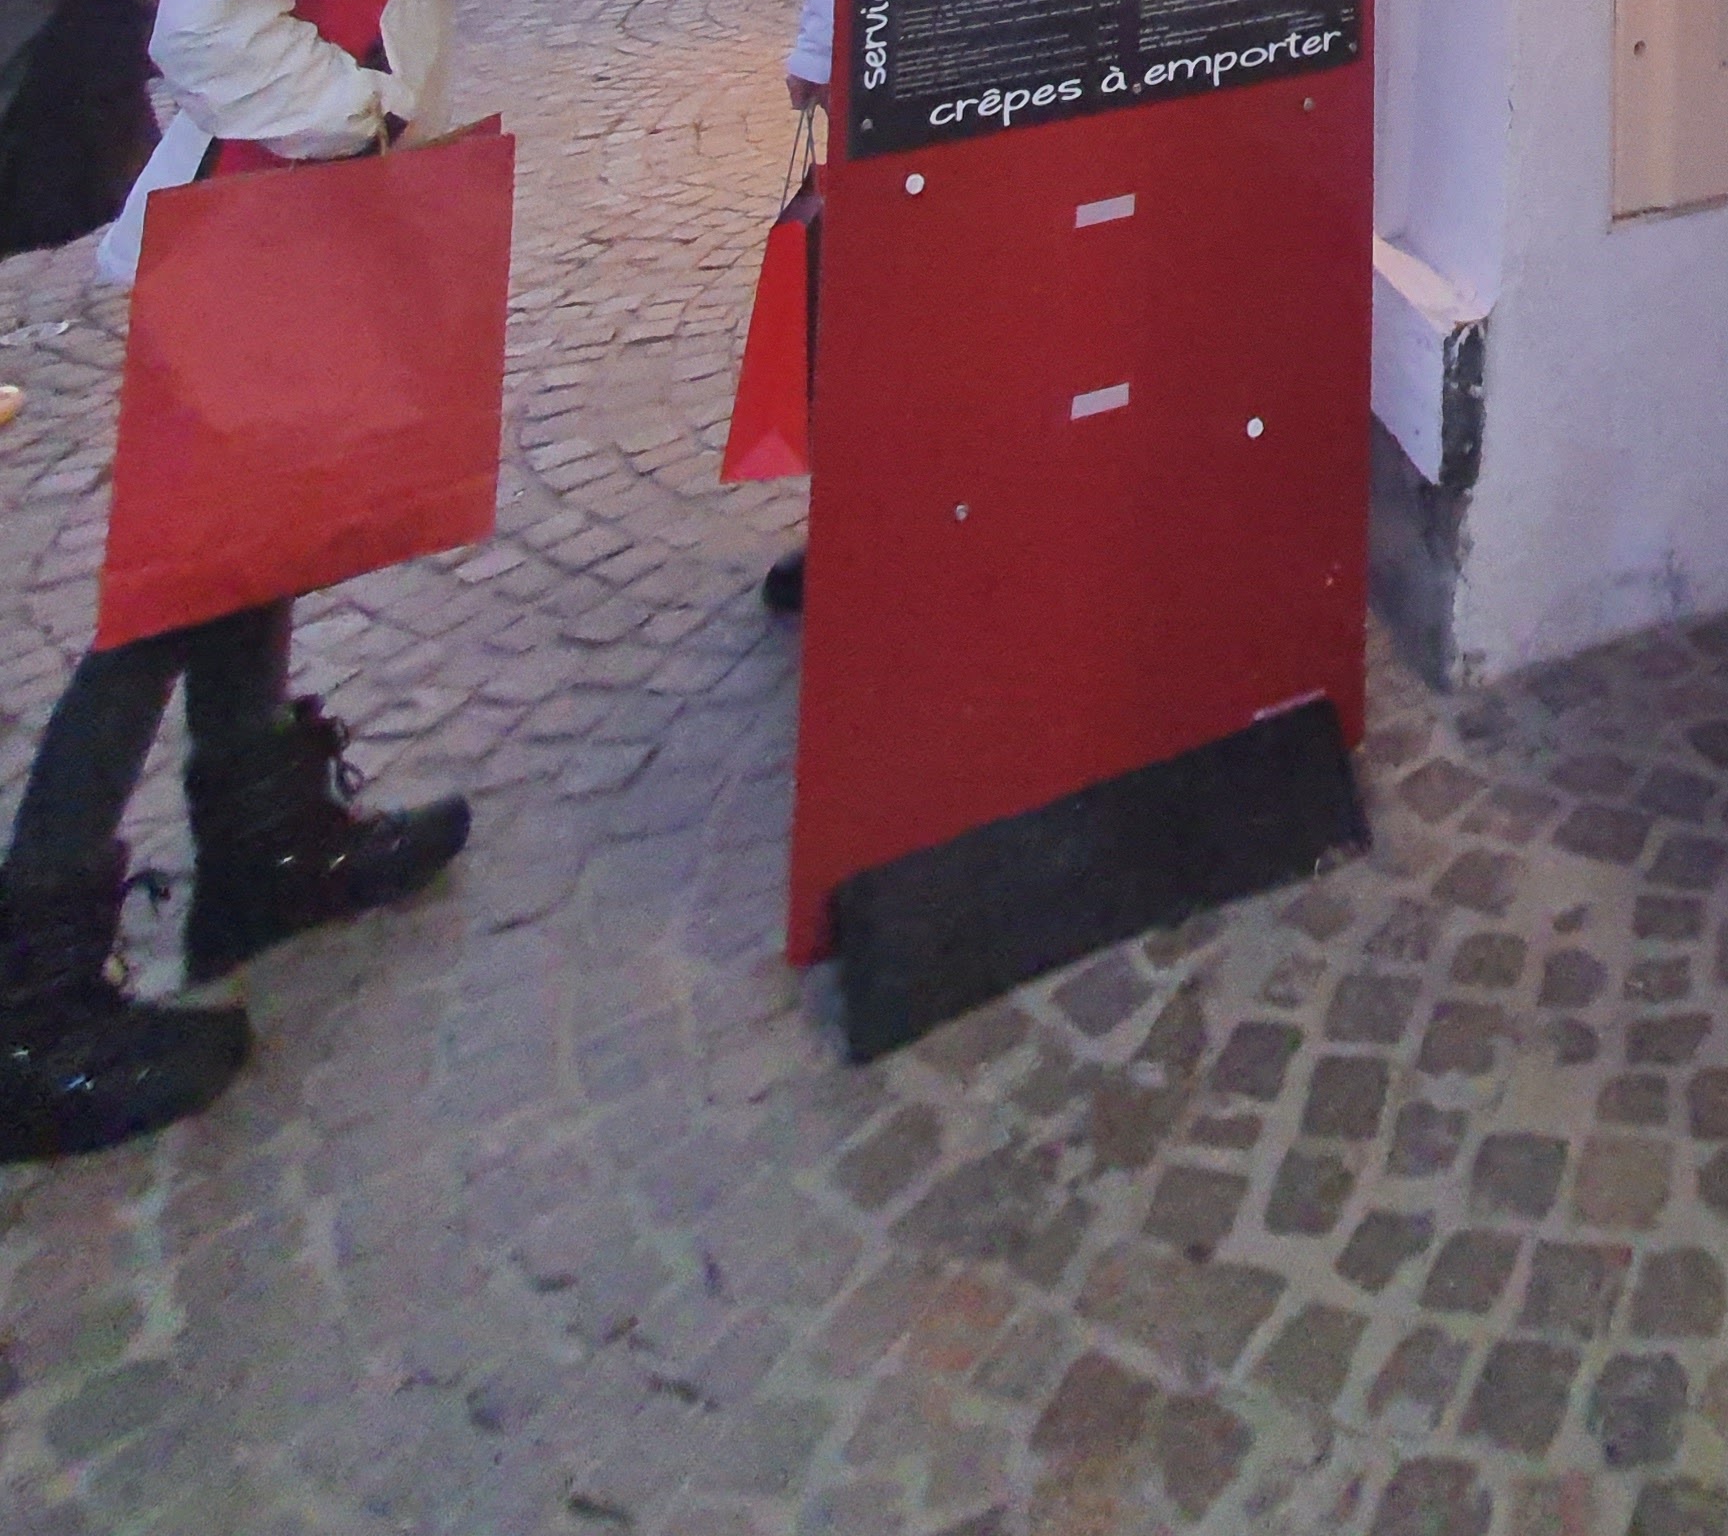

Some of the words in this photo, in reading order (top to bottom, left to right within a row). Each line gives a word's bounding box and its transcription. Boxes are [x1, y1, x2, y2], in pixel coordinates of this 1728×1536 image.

[929, 76, 1082, 127] crêpes
[1101, 67, 1127, 94] à
[1143, 30, 1342, 87] emporter
